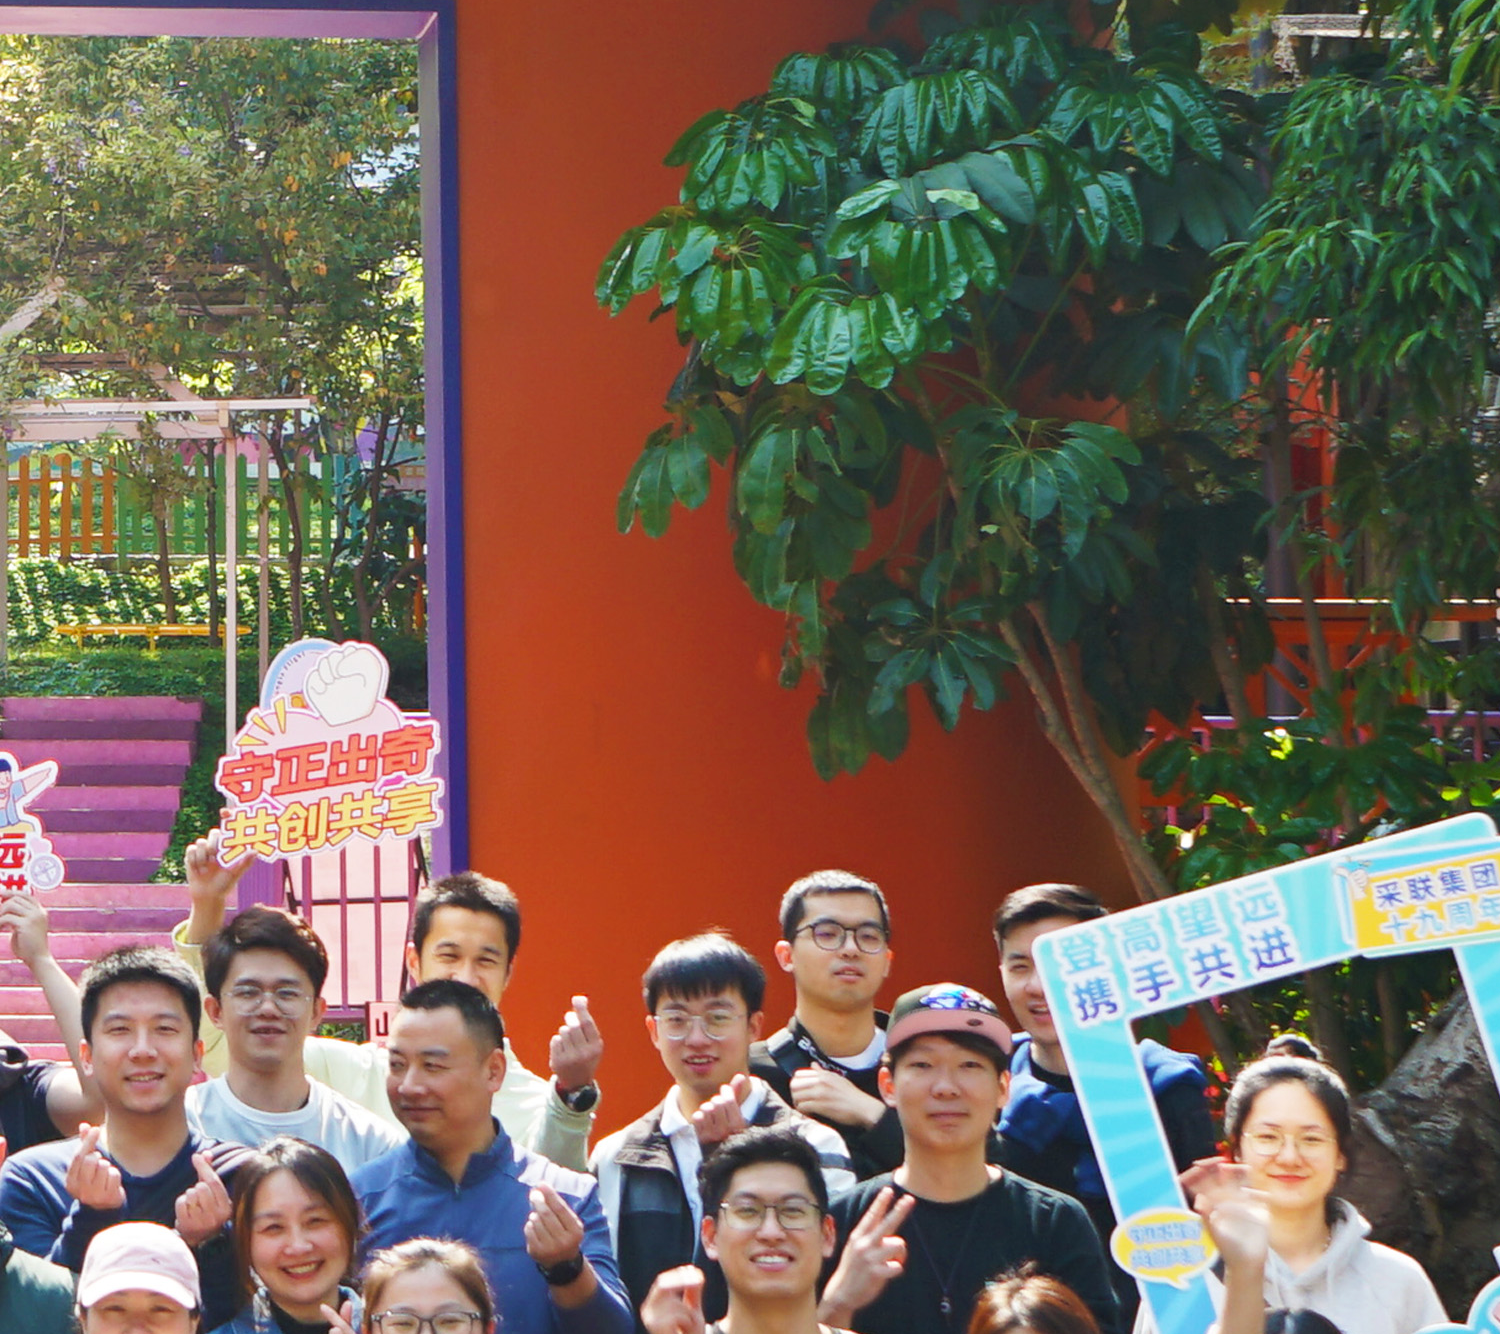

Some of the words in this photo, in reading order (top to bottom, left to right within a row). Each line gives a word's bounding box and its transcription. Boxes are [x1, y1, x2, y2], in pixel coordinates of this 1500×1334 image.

[219, 724, 435, 804] 守正出奇
[221, 781, 439, 864] 共创共享
[1374, 862, 1500, 908] 采联集团
[1057, 880, 1280, 976] 登高望远
[1072, 924, 1296, 1022] 携手共进
